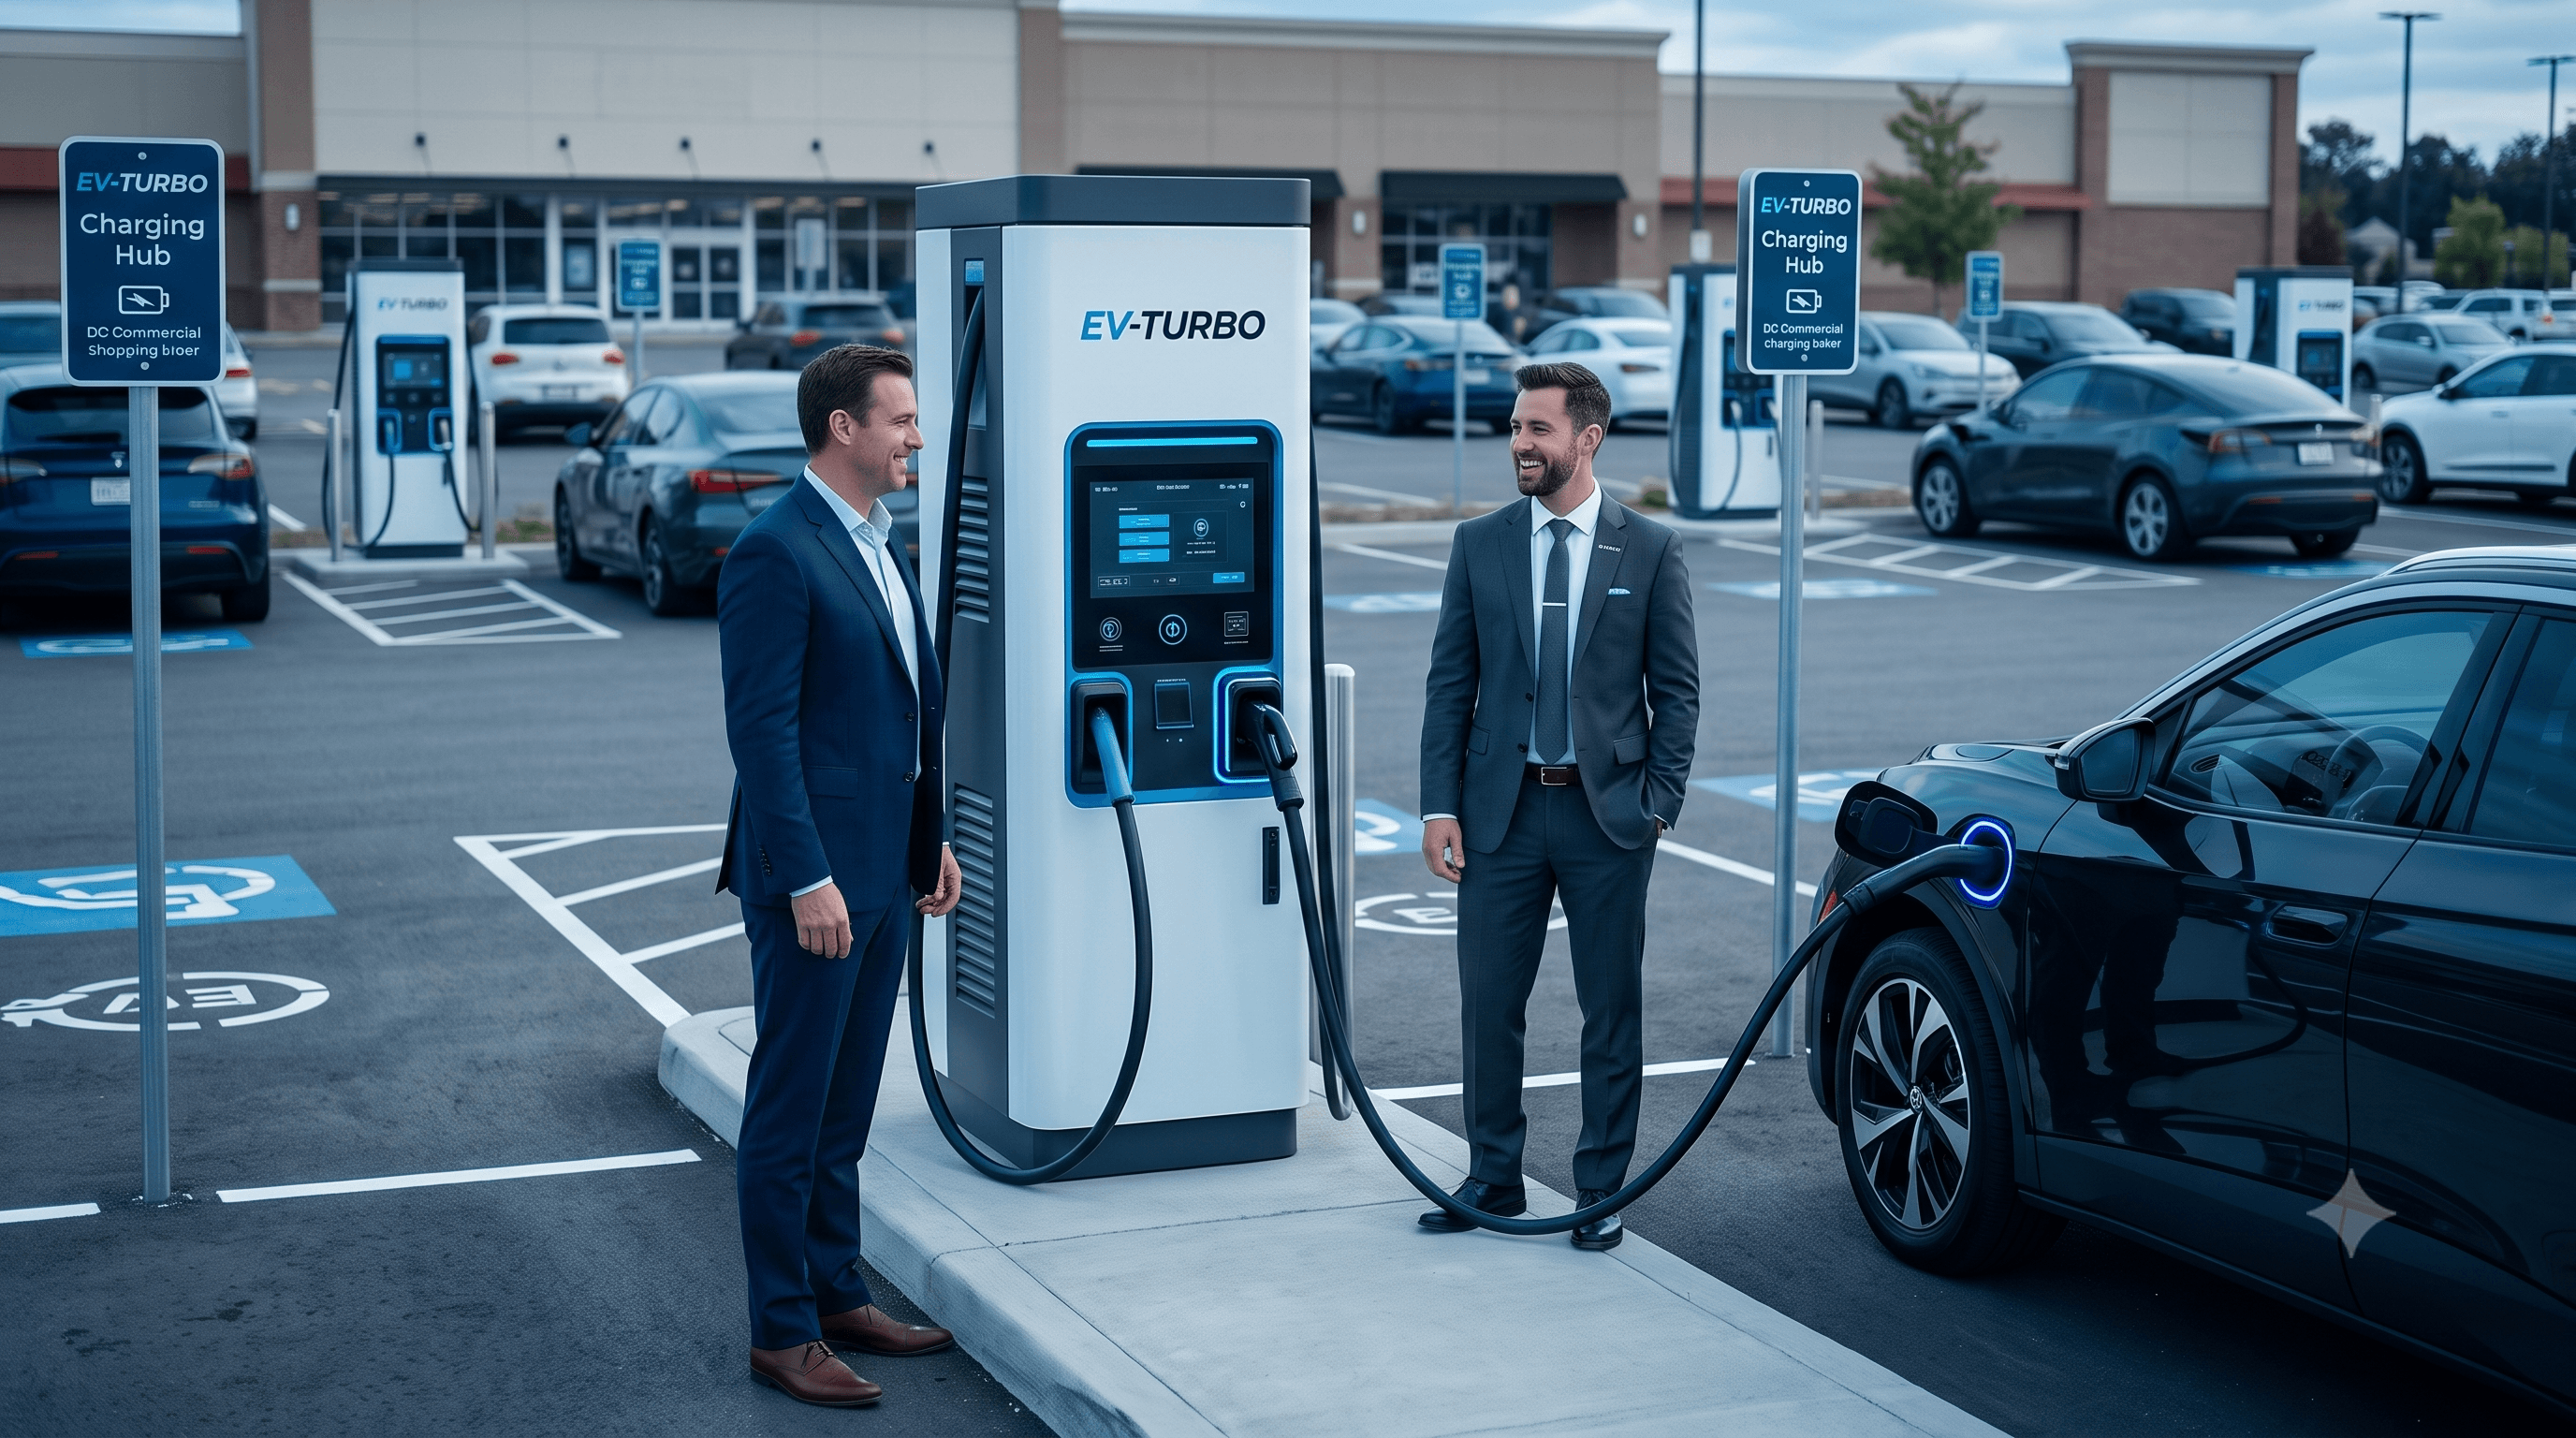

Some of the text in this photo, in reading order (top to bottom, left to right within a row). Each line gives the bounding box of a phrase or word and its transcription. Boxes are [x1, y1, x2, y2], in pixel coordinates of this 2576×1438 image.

[76, 172, 208, 193] EV-TURBO
[1761, 197, 1852, 215] EV-TURBO
[80, 213, 204, 241] Charging
[1762, 229, 1848, 253] Charging
[116, 243, 170, 266] Hub
[1785, 256, 1824, 273] Hub
[87, 327, 201, 338] DC Commercial
[1080, 310, 1266, 340] EV-TURBO
[1764, 323, 1843, 334] DC Commercial
[88, 344, 158, 359] Shopping
[1764, 338, 1842, 351] charging baker
